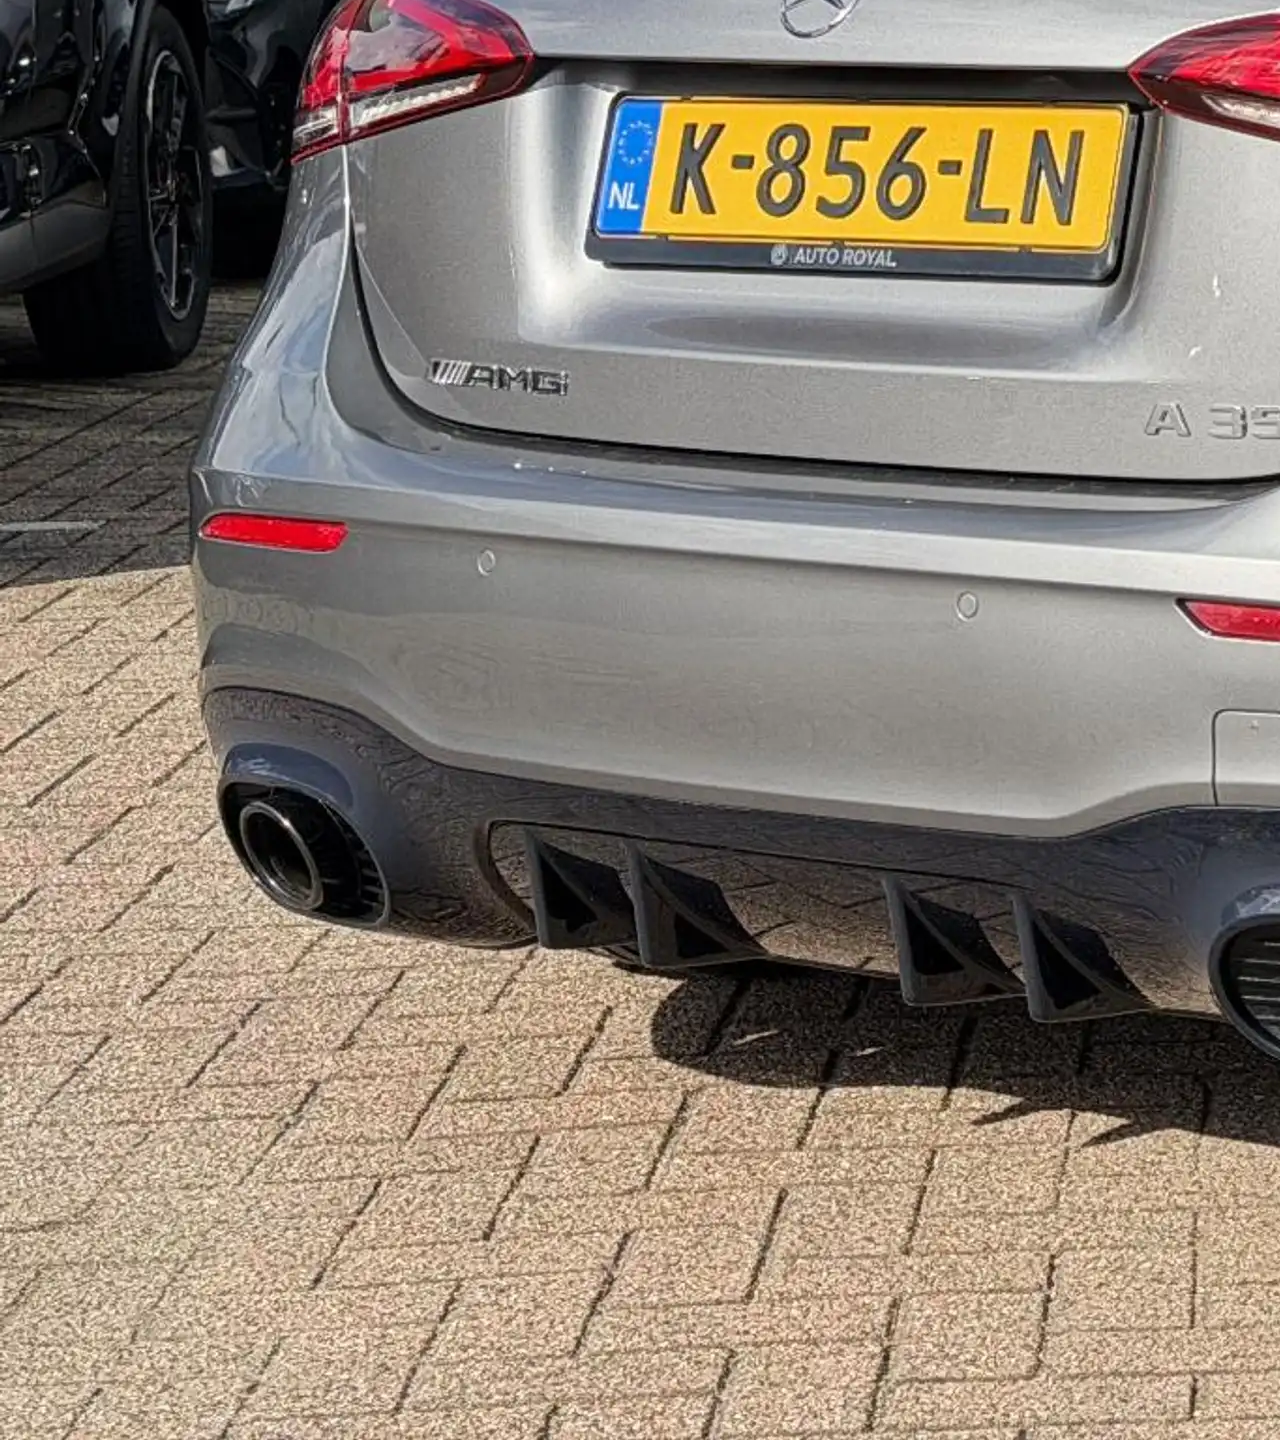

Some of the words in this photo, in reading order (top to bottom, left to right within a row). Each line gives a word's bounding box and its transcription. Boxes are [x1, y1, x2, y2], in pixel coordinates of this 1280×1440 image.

[607, 181, 641, 210] NL
[670, 122, 1085, 226] K-856-LN
[794, 246, 839, 264] AUTO
[1144, 402, 1192, 438] A
